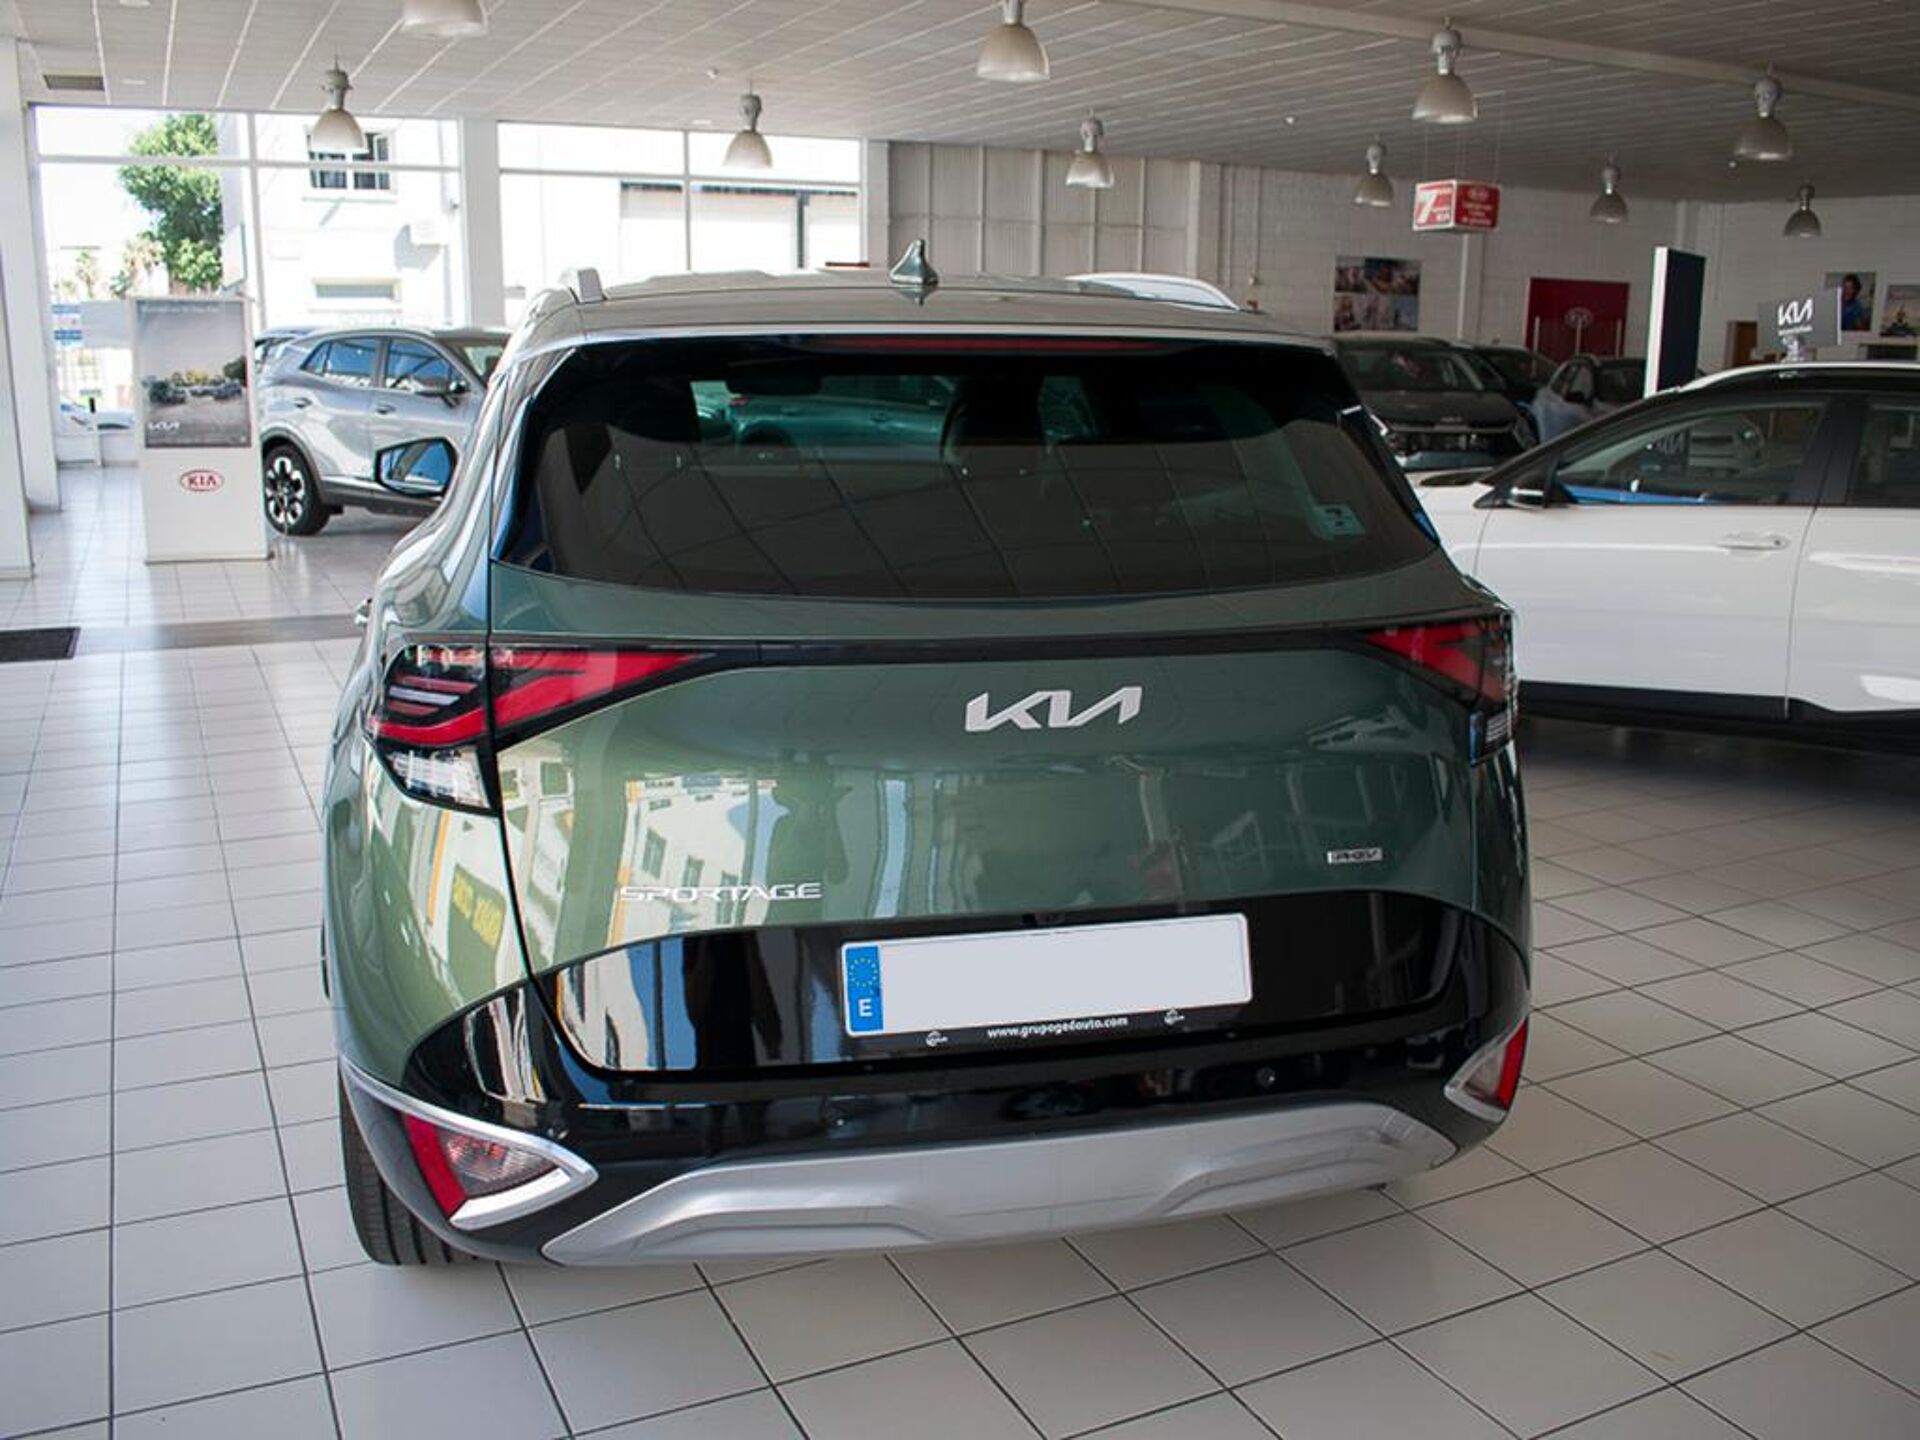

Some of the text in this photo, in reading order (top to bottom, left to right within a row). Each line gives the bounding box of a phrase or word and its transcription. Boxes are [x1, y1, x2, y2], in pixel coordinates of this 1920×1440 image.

[1777, 298, 1814, 326] KIA
[187, 475, 217, 487] KIA
[965, 686, 1142, 732] KIA
[618, 882, 823, 903] SPORTAGE
[859, 998, 873, 1017] E
